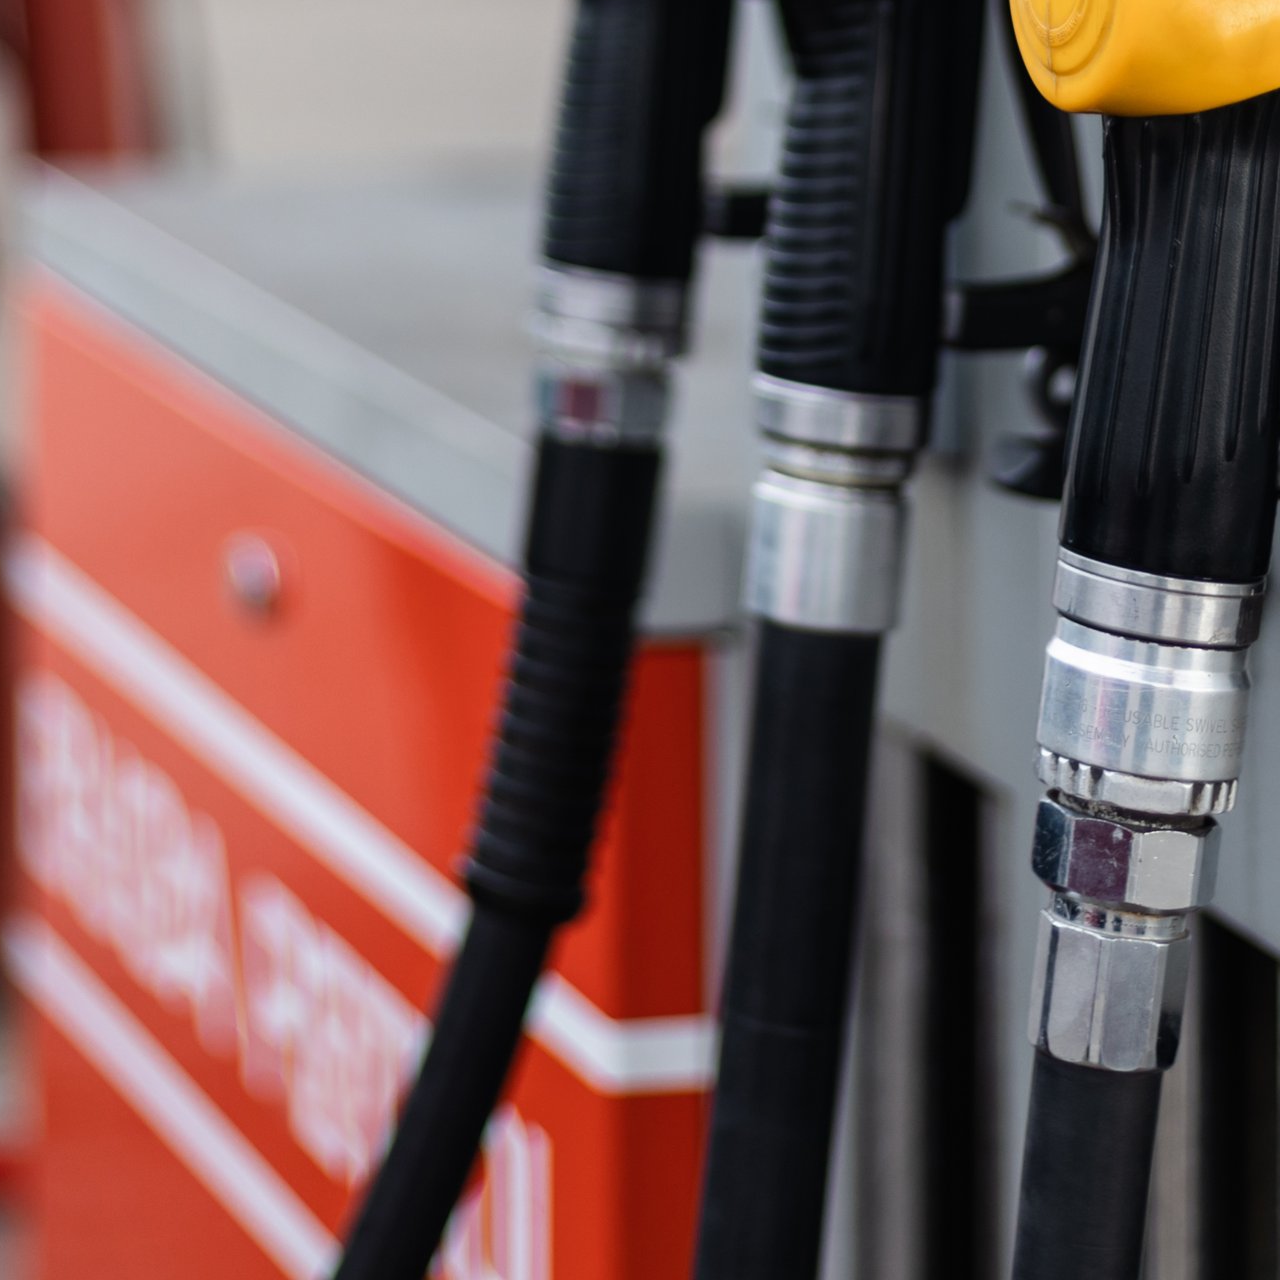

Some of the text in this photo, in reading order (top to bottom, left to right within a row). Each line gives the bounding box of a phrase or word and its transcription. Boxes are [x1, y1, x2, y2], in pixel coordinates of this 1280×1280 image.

[1064, 720, 1130, 748] SSEMBLY
[1146, 739, 1221, 759] AUTHORISED
[1186, 718, 1227, 734] SWIVEL
